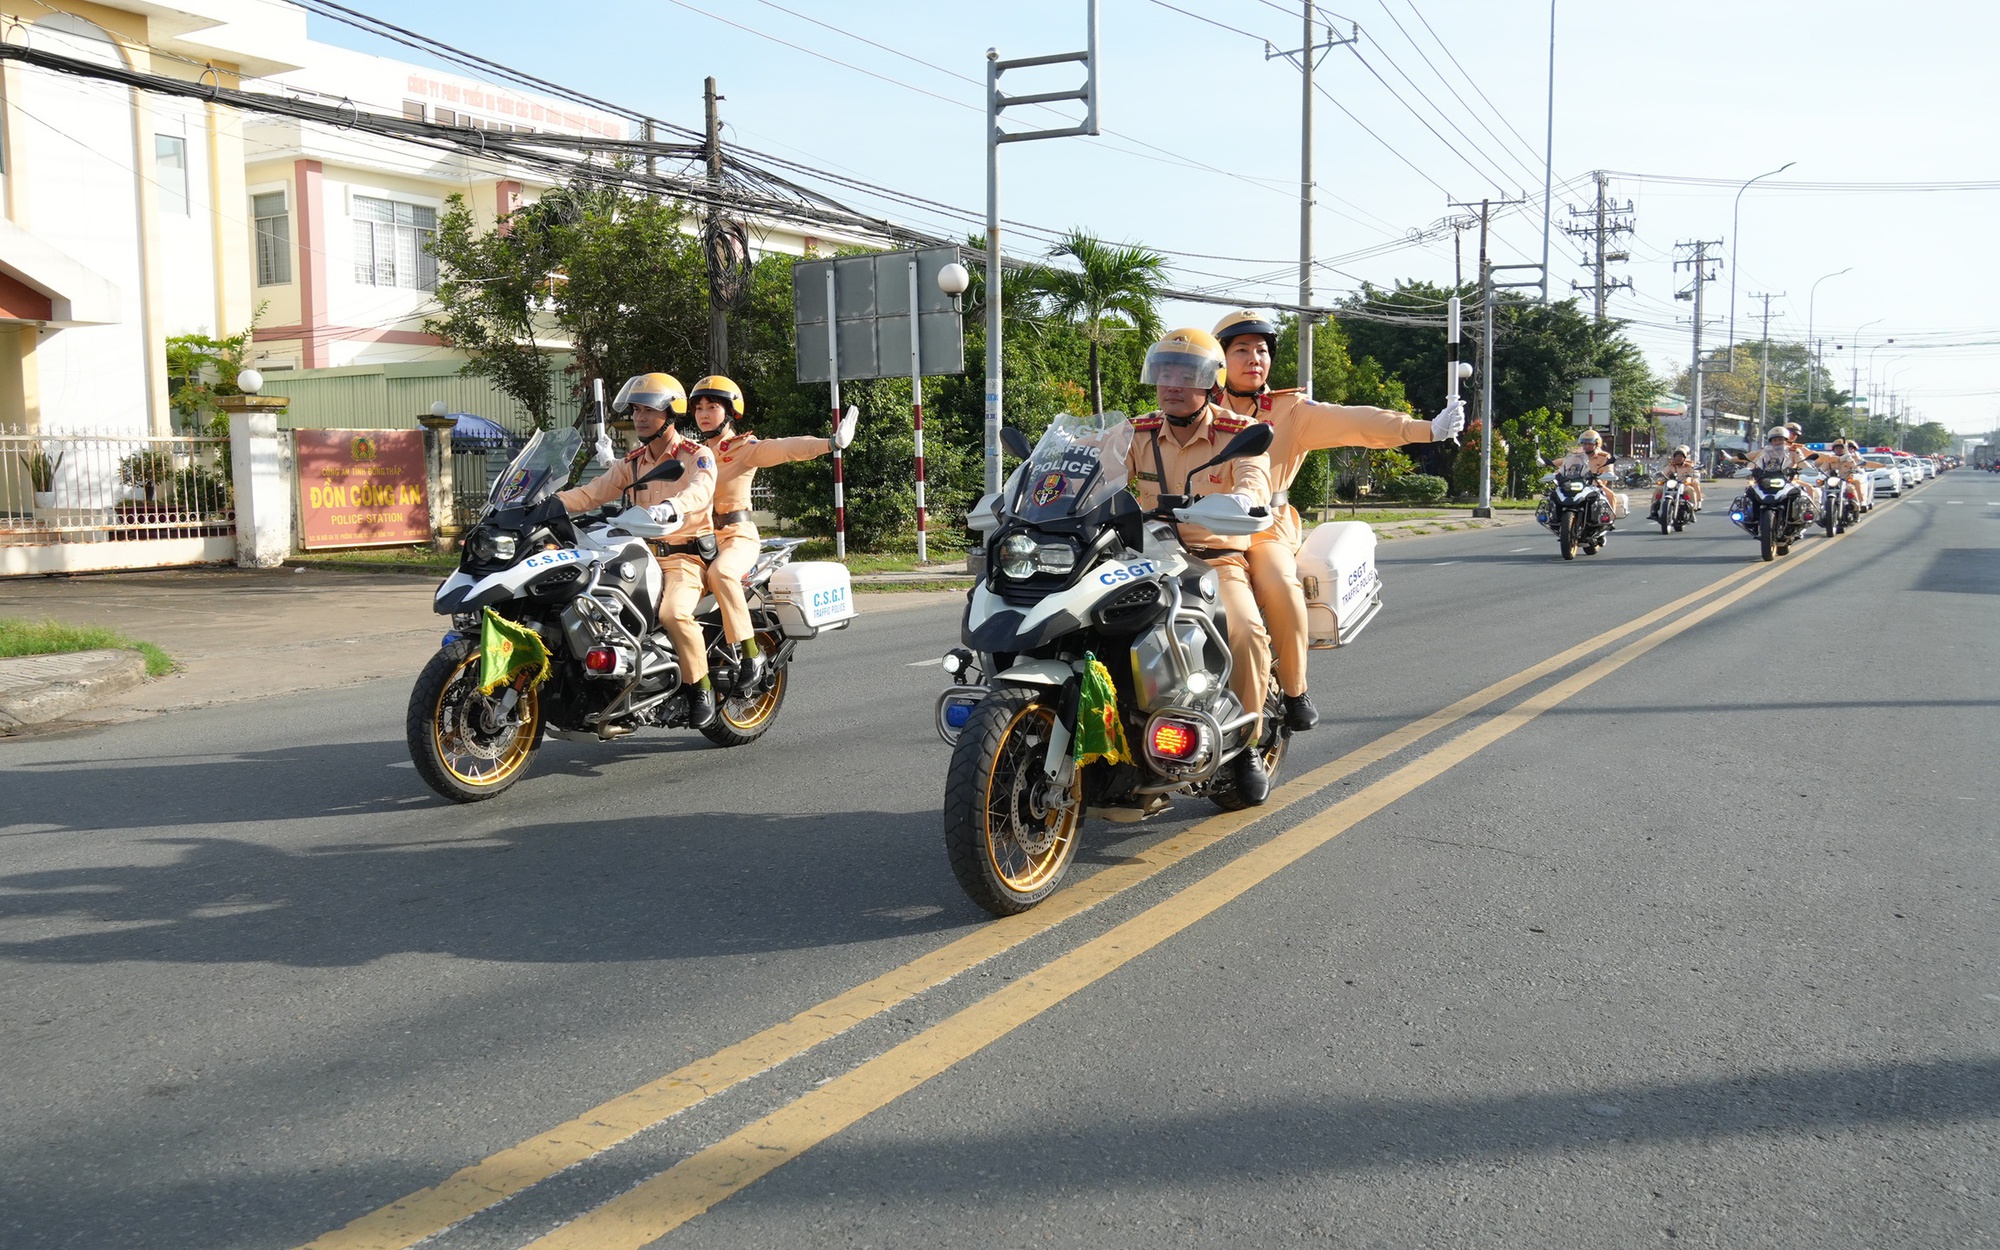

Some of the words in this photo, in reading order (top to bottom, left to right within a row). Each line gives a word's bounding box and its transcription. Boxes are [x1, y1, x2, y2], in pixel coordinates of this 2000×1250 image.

[1031, 460, 1094, 475] POLICE
[310, 478, 346, 508] ĐỒN
[351, 480, 395, 506] CÔNG
[399, 484, 421, 505] AN
[331, 514, 363, 525] POLICE
[367, 513, 403, 523] STATION
[526, 550, 581, 567] C.S.G.T
[1099, 562, 1155, 585] CSGT
[1348, 561, 1367, 586] CSGT
[814, 587, 845, 607] C.S.G.T
[1342, 583, 1360, 606] TRAFFIC
[1359, 571, 1374, 592] POLICE
[814, 606, 831, 619] TRAFFIC
[831, 603, 845, 614] POLICE
